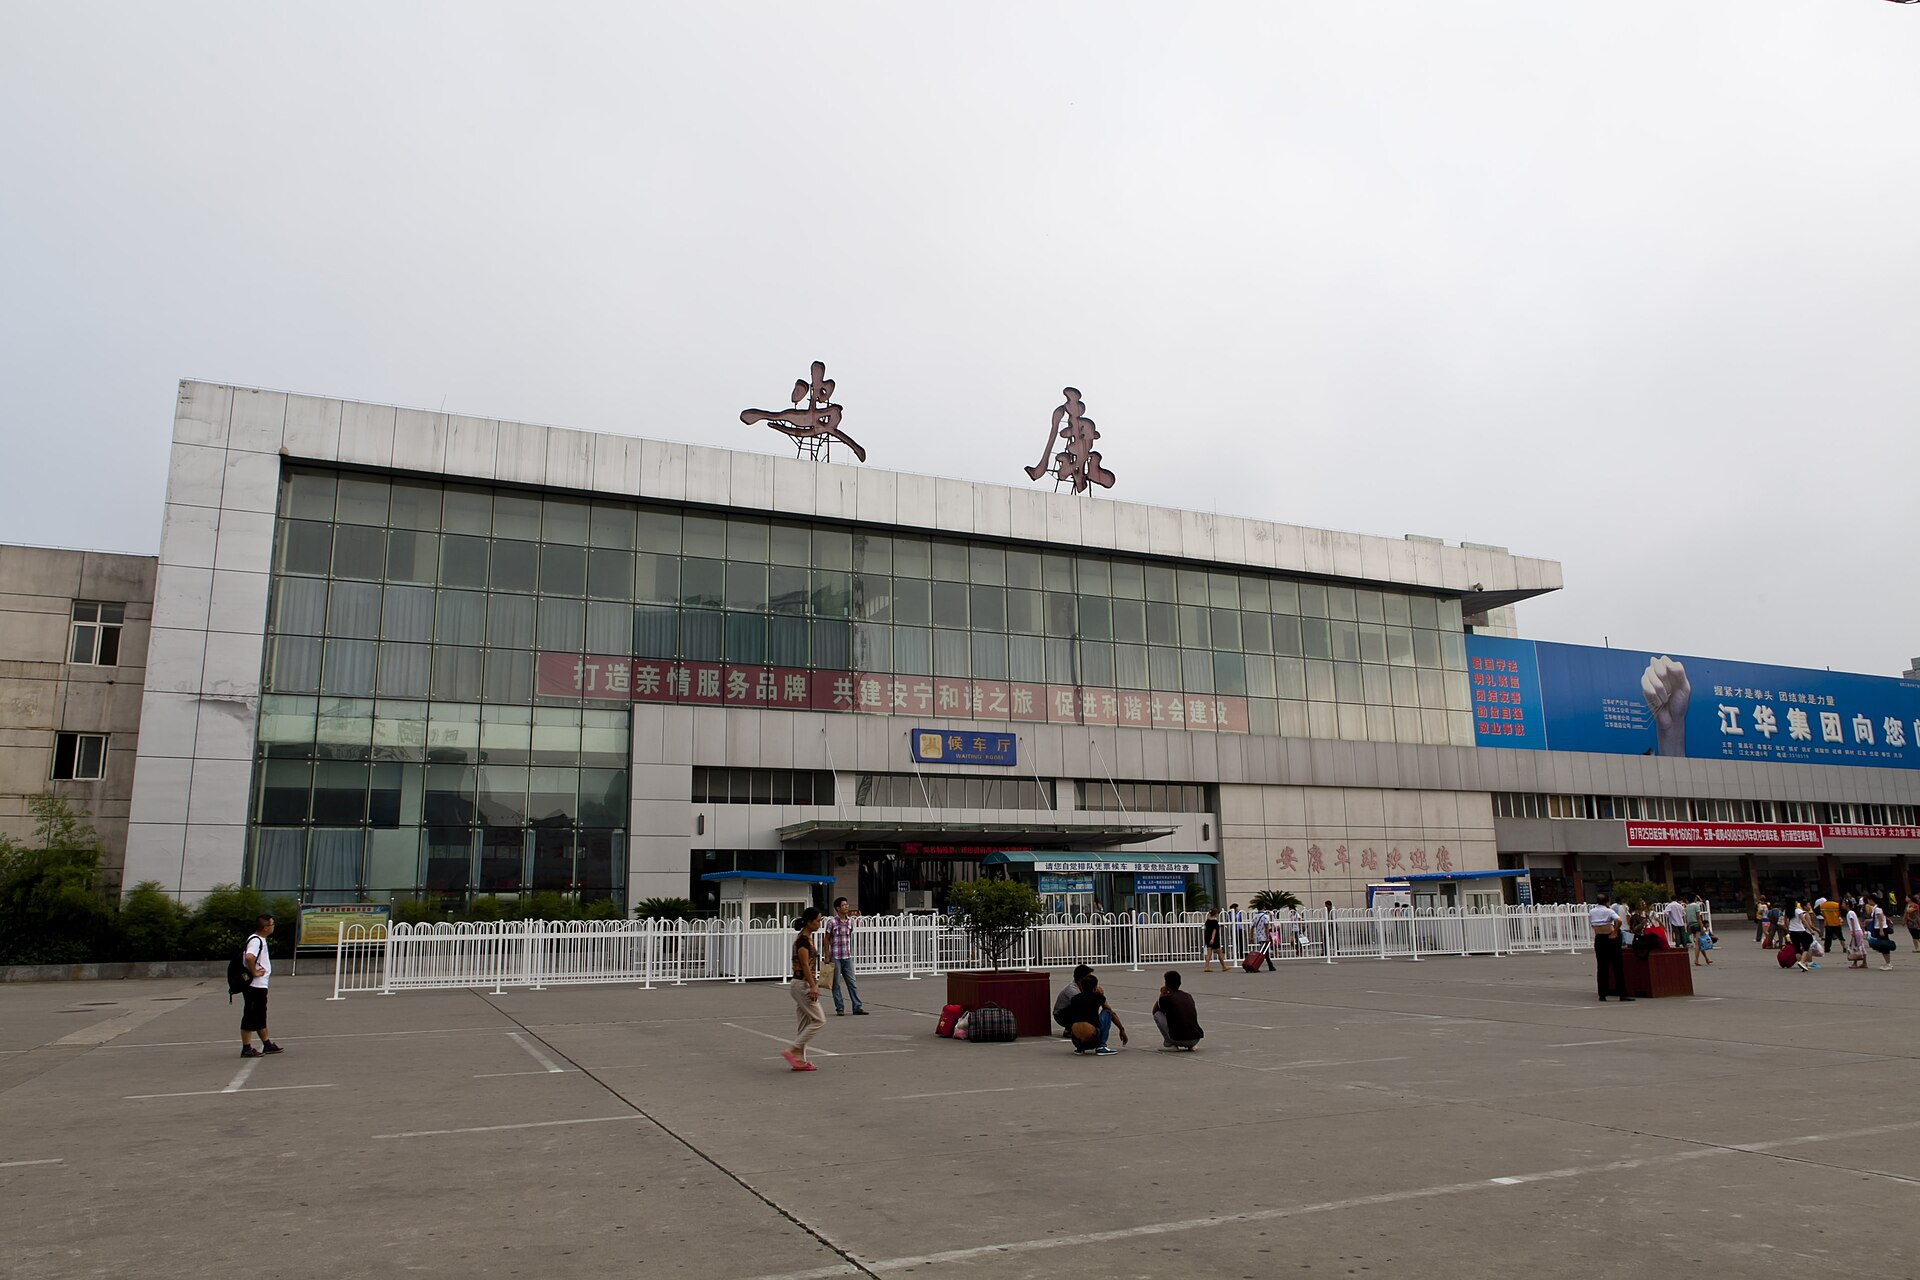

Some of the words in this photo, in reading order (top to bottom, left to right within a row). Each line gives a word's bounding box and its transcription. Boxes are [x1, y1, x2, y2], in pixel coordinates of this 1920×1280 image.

[739, 361, 1116, 493] 安康
[573, 660, 807, 702] 打造亲情服务品牌
[832, 677, 1033, 715] 共建安宁和谐之旅
[1055, 690, 1229, 725] 促进和谐社会建设
[1714, 685, 1773, 701] 握紧才是拳头
[1778, 691, 1835, 706] 团结就是力量
[947, 735, 1011, 753] 候车厅
[1045, 862, 1128, 871] 请您自觉排队凭票候车
[1134, 863, 1190, 871] 接受危险品检查
[1276, 843, 1453, 874] 安康车站欢迎您
